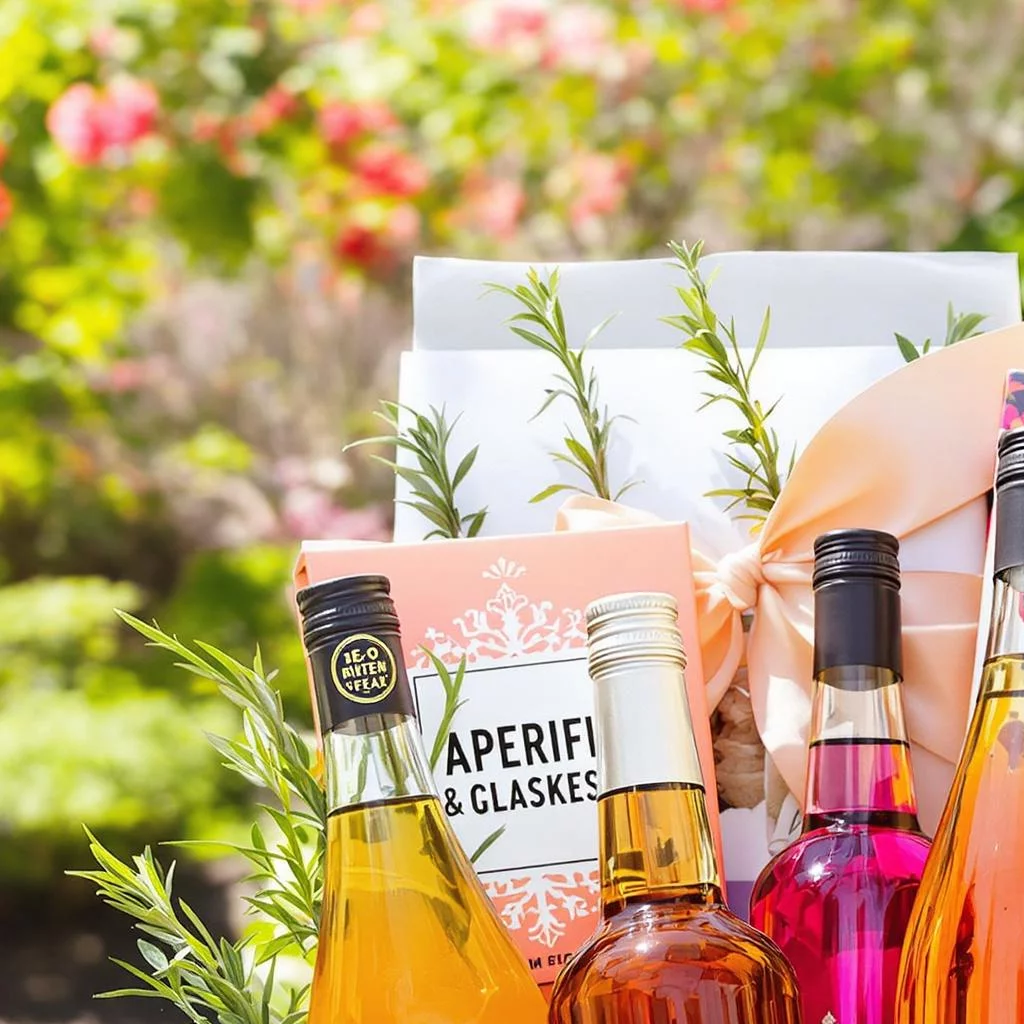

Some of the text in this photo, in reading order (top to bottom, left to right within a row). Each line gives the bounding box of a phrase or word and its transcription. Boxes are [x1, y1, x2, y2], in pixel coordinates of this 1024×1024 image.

[446, 716, 596, 776] APERIFI
[444, 770, 597, 816] & GLASKES
